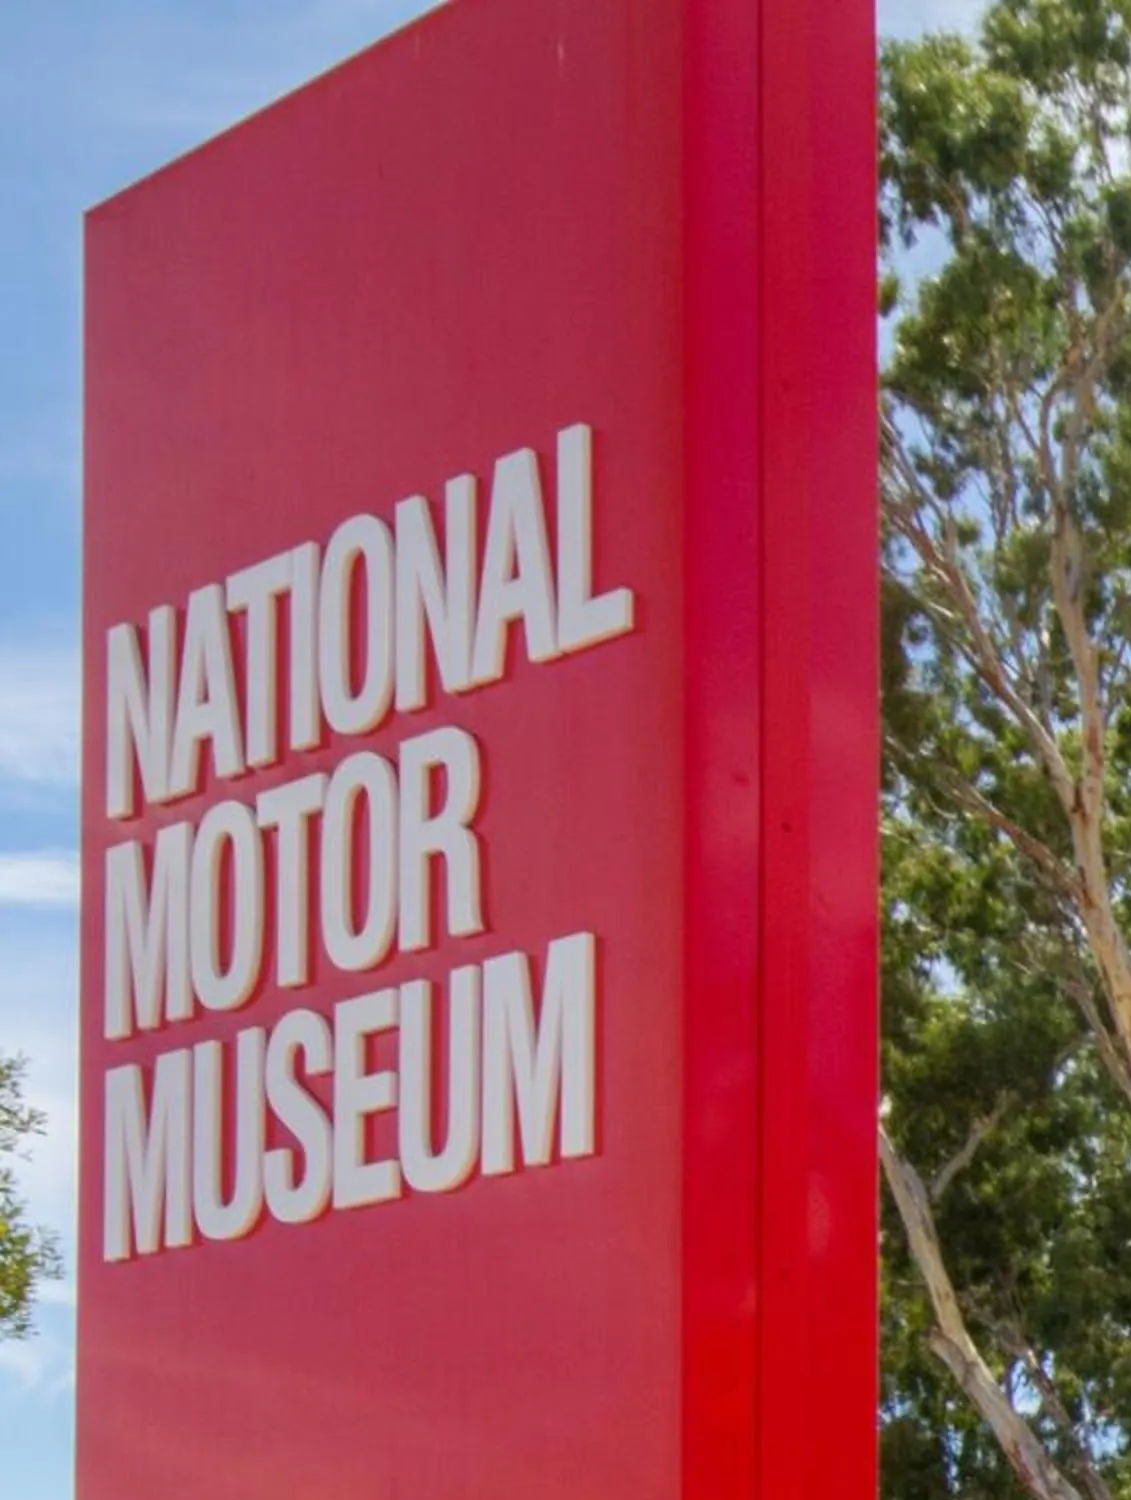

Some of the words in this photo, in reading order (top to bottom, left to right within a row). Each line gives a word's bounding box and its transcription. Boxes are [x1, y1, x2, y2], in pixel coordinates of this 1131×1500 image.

[106, 423, 633, 820] NATIONAL
[104, 726, 483, 1041] MOTOR
[104, 931, 595, 1262] MUSEUM
